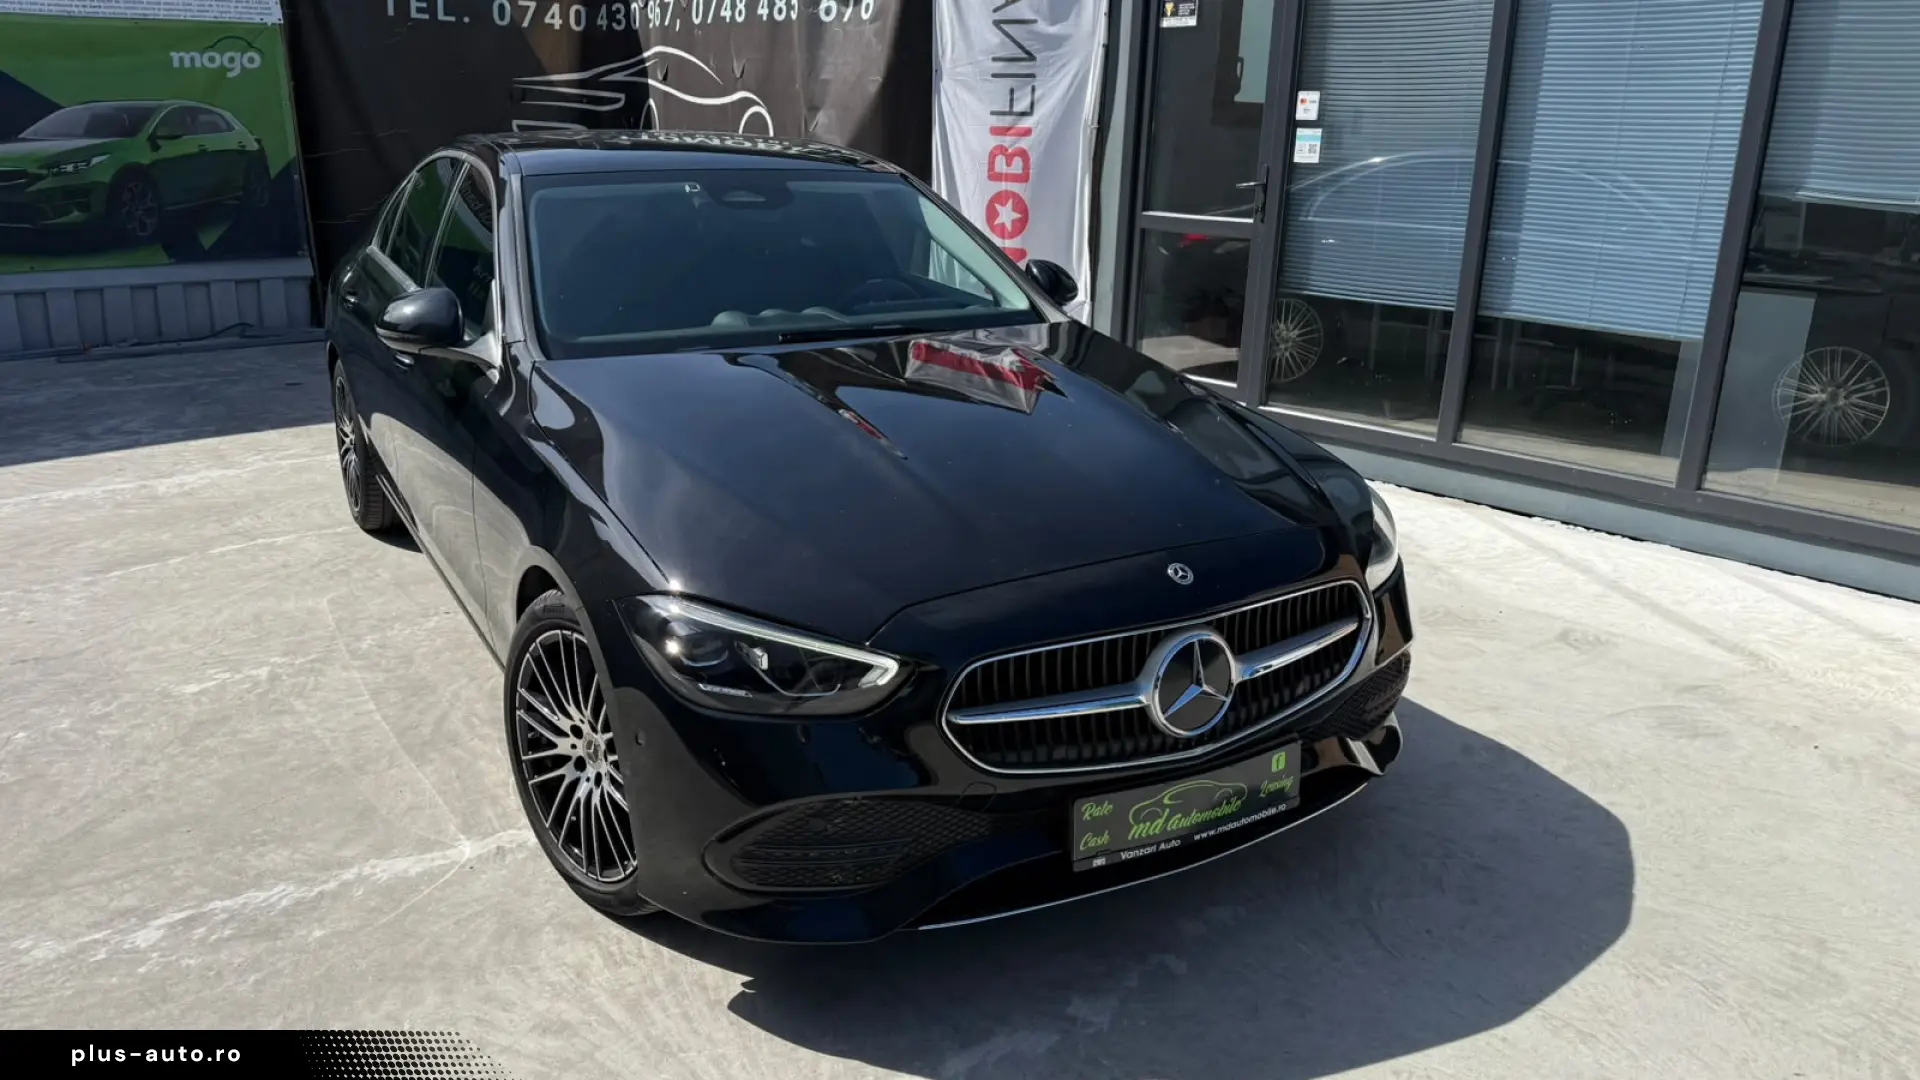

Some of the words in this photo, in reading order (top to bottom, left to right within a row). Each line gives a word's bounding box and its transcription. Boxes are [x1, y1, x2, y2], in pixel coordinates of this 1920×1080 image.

[492, 0, 586, 31] 0740
[597, 3, 639, 31] 430
[168, 51, 262, 78] mogo
[1081, 800, 1113, 820] Rate
[1194, 803, 1287, 841] www.mdautomobile.ro
[1128, 808, 1169, 840] md
[1080, 830, 1111, 850] Cash
[1159, 839, 1181, 852] Auto
